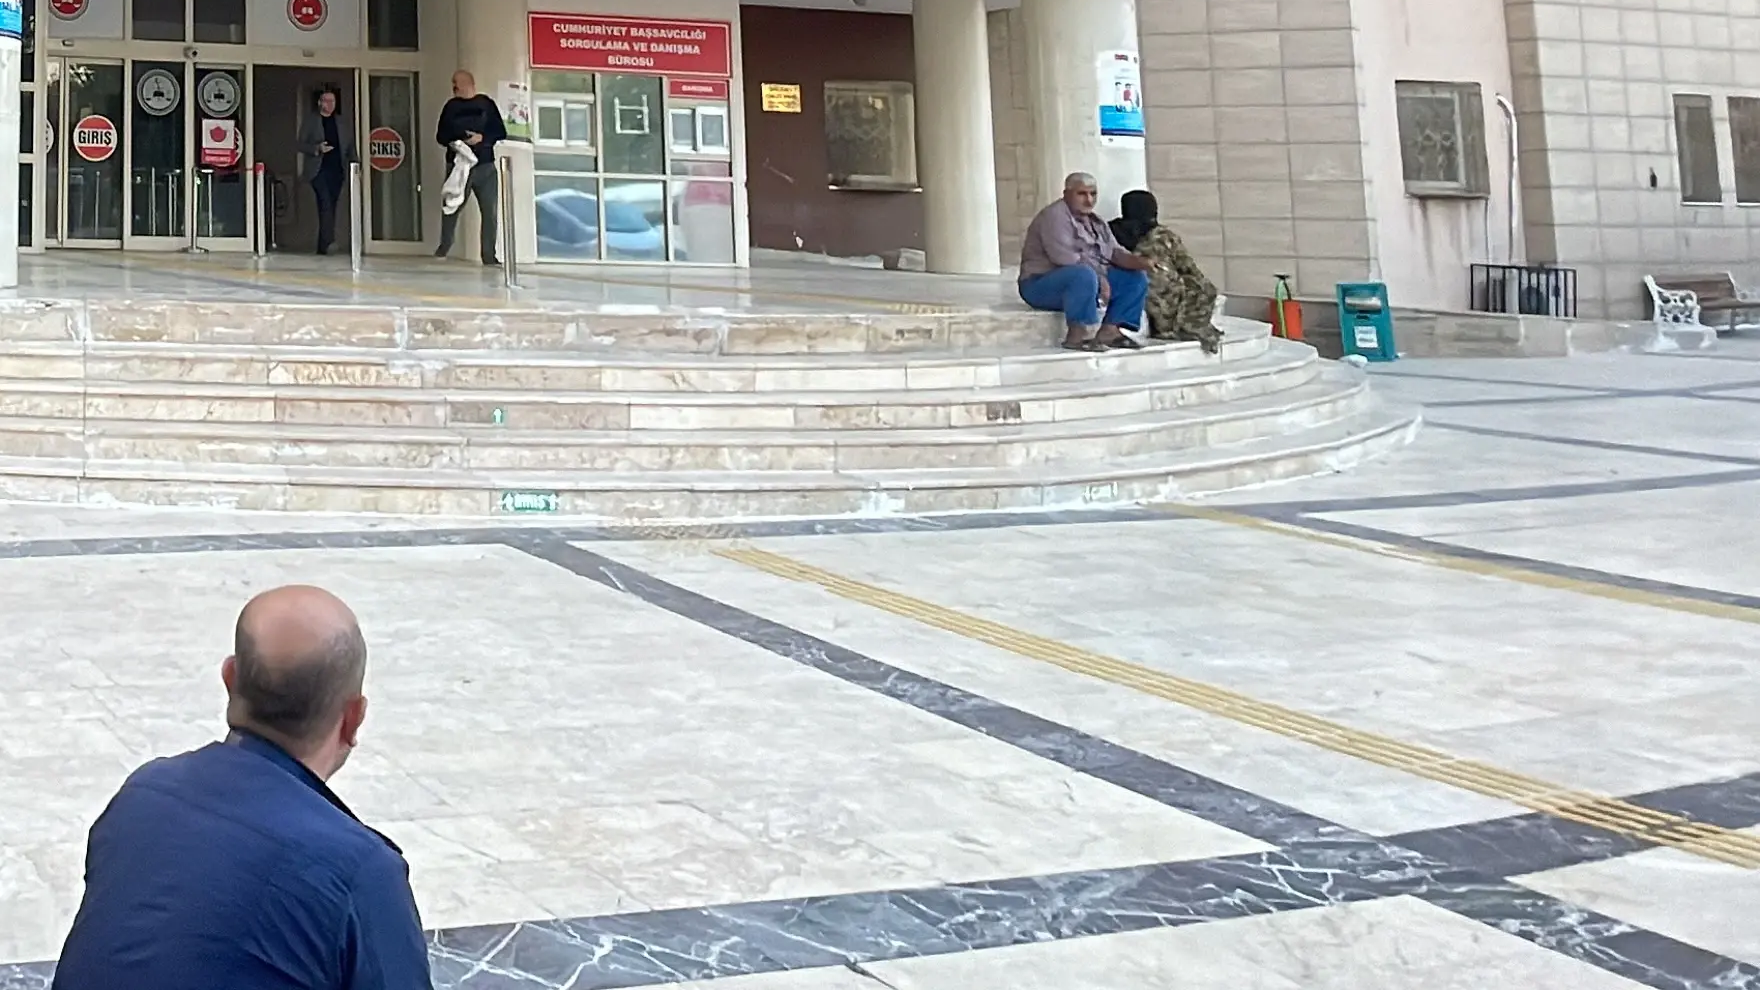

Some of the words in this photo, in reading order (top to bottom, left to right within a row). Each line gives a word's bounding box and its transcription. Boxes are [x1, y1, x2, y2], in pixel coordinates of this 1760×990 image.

[552, 23, 627, 36] CUMHURİYET
[559, 38, 630, 52] SORGULAMA
[633, 42, 648, 52] VE
[650, 43, 701, 55] DANIŞMA
[607, 55, 654, 67] BÜROSU
